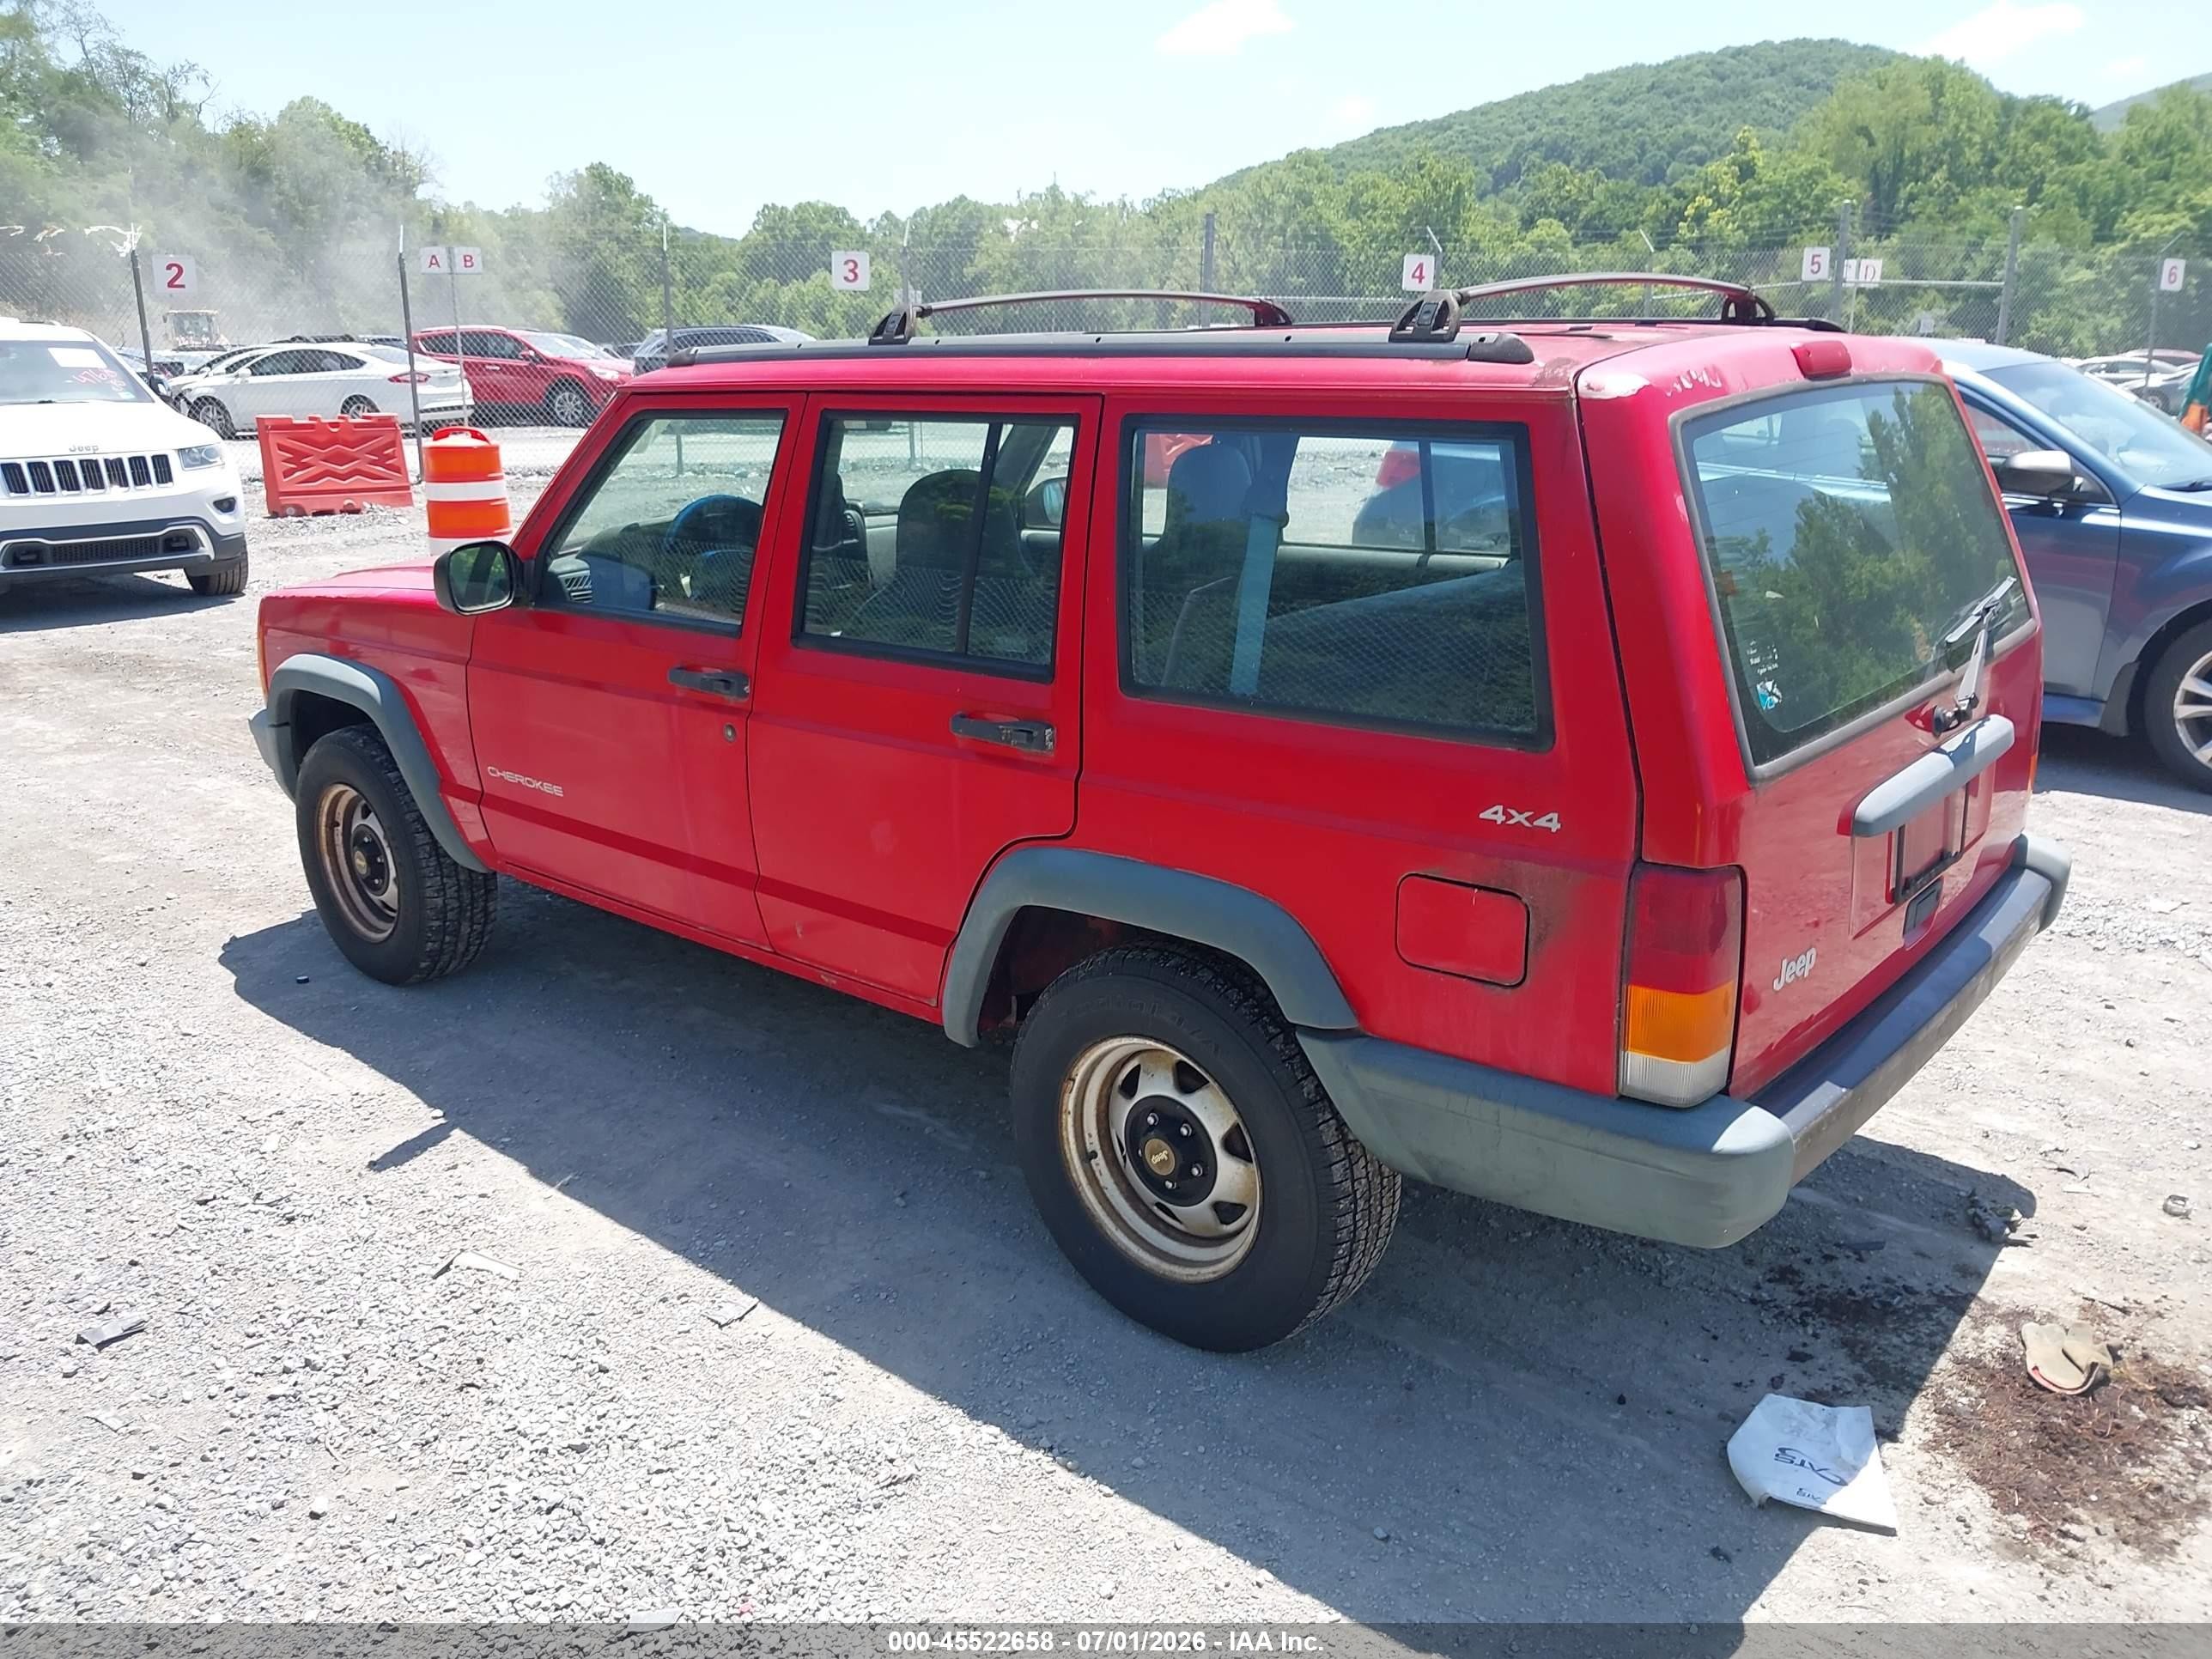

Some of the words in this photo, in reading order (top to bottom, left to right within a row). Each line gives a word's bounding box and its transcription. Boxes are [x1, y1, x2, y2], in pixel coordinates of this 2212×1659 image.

[428, 253, 441, 269] A
[462, 254, 475, 269] B
[842, 258, 859, 283] 3
[1809, 253, 1822, 275] 5
[165, 262, 186, 289] 2
[1411, 261, 1425, 284] 4
[1864, 264, 1876, 281] D
[2167, 265, 2179, 284] 6
[486, 765, 564, 798] CHEROKEE
[1772, 946, 1818, 992] Jeep
